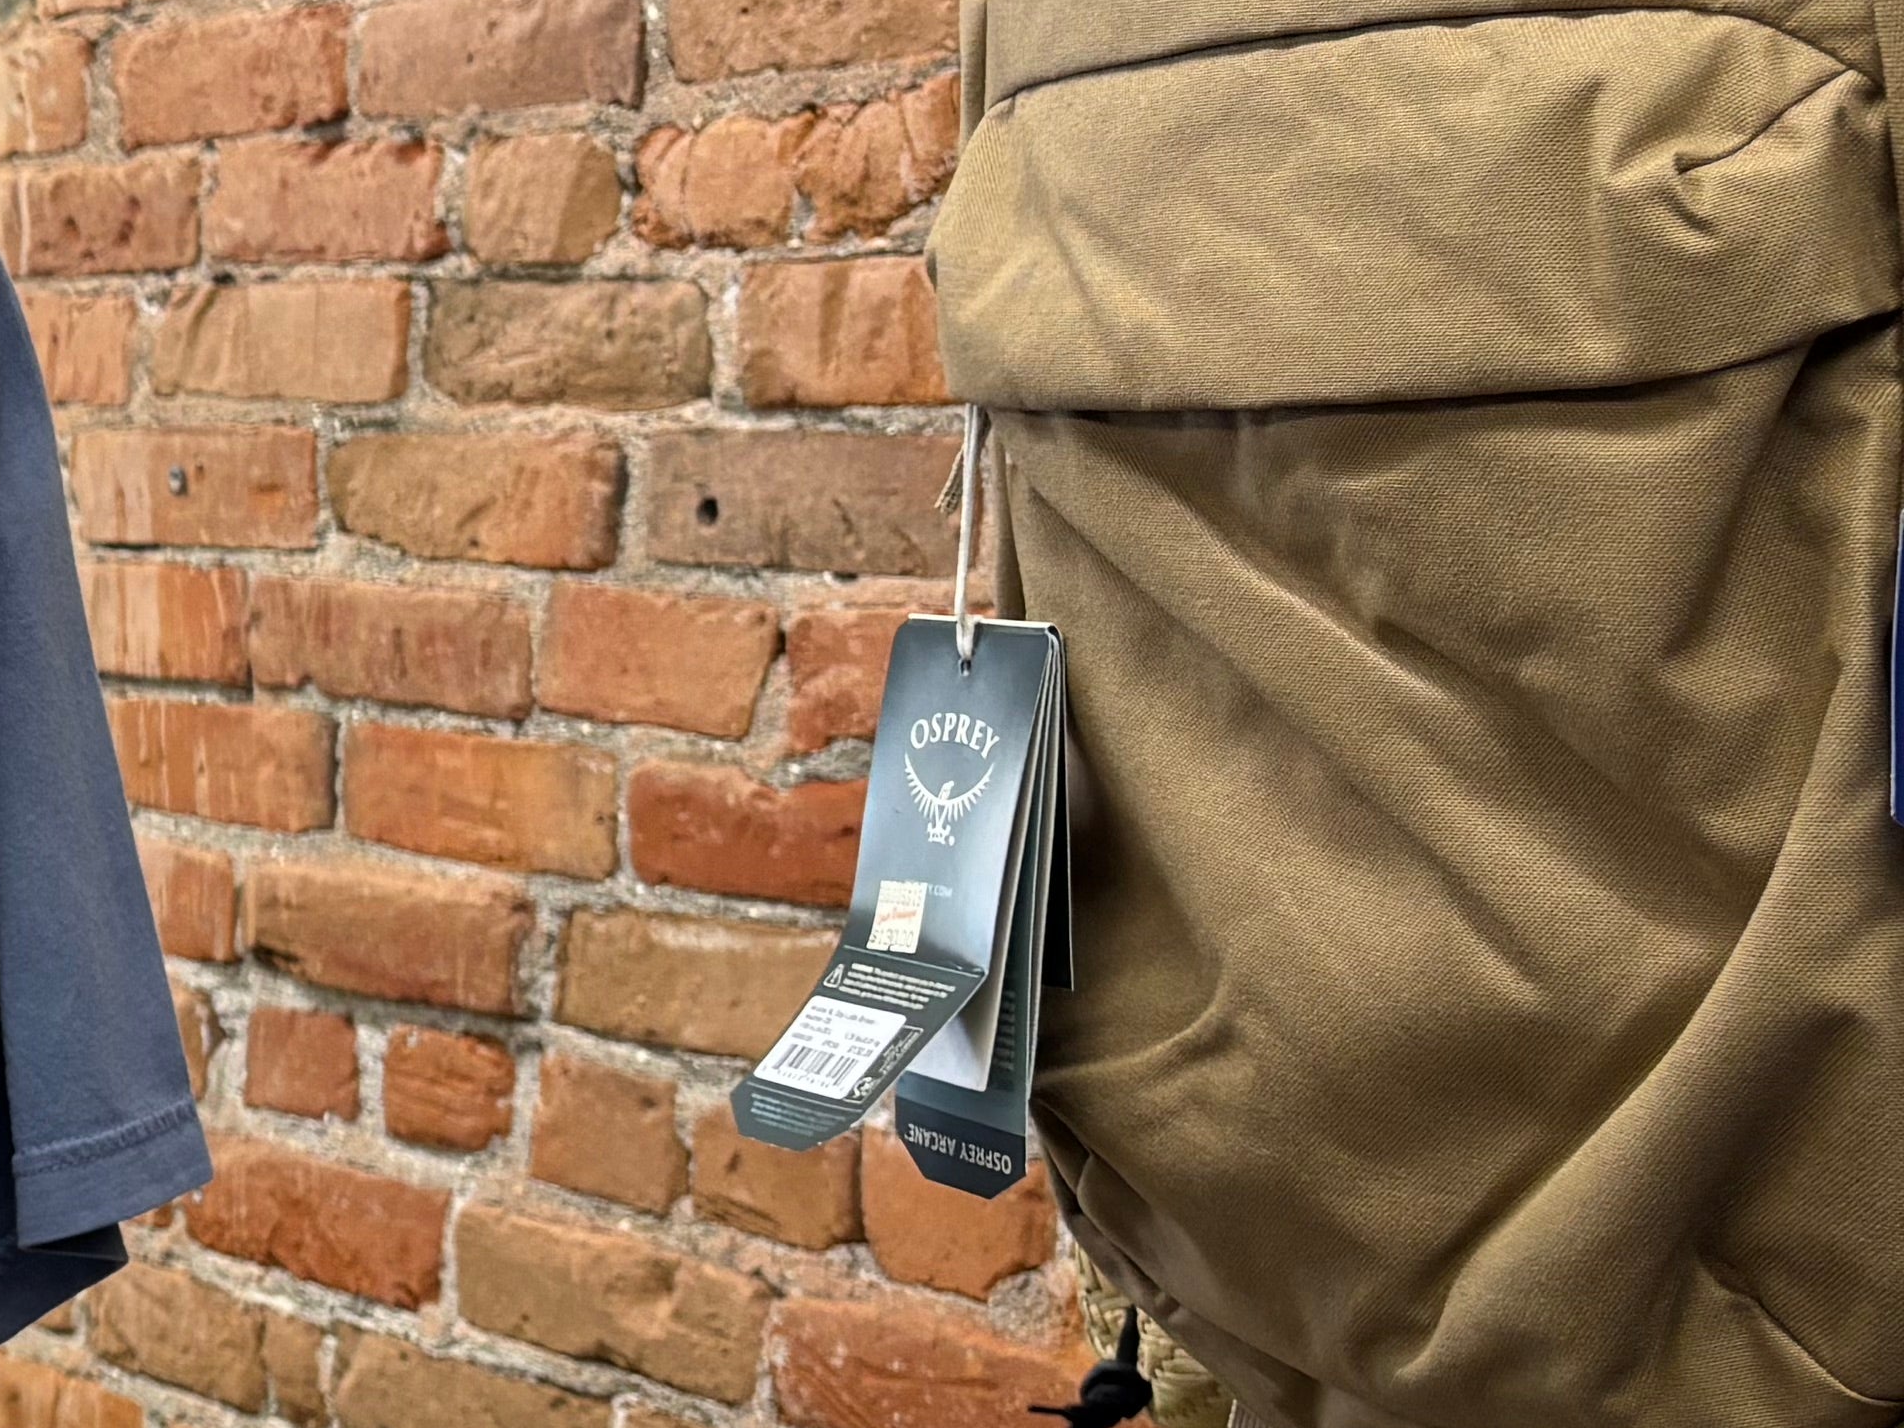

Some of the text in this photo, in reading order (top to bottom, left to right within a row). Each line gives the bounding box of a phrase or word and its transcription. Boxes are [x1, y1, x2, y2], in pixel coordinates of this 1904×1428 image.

[909, 711, 1002, 761] OSPREY
[905, 1122, 1013, 1175] OSPREY ARCANE
